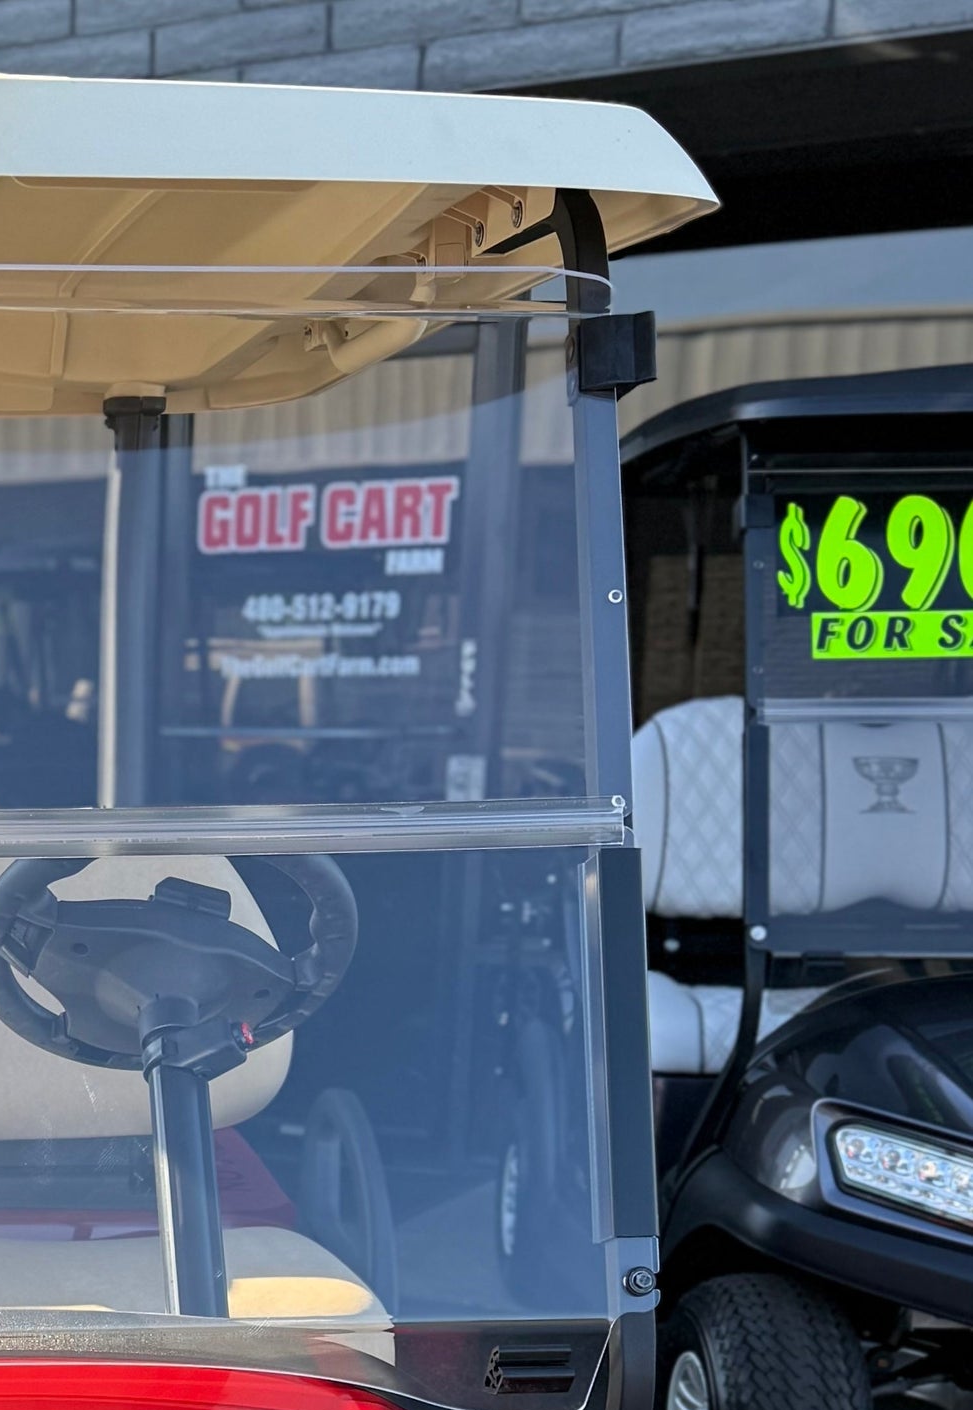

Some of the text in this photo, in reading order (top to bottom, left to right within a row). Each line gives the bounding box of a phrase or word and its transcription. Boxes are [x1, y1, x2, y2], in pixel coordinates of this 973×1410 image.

[198, 476, 459, 554] GOLF CART
[385, 549, 445, 576] FARM
[777, 494, 973, 612] $69
[816, 614, 973, 651] FOR S
